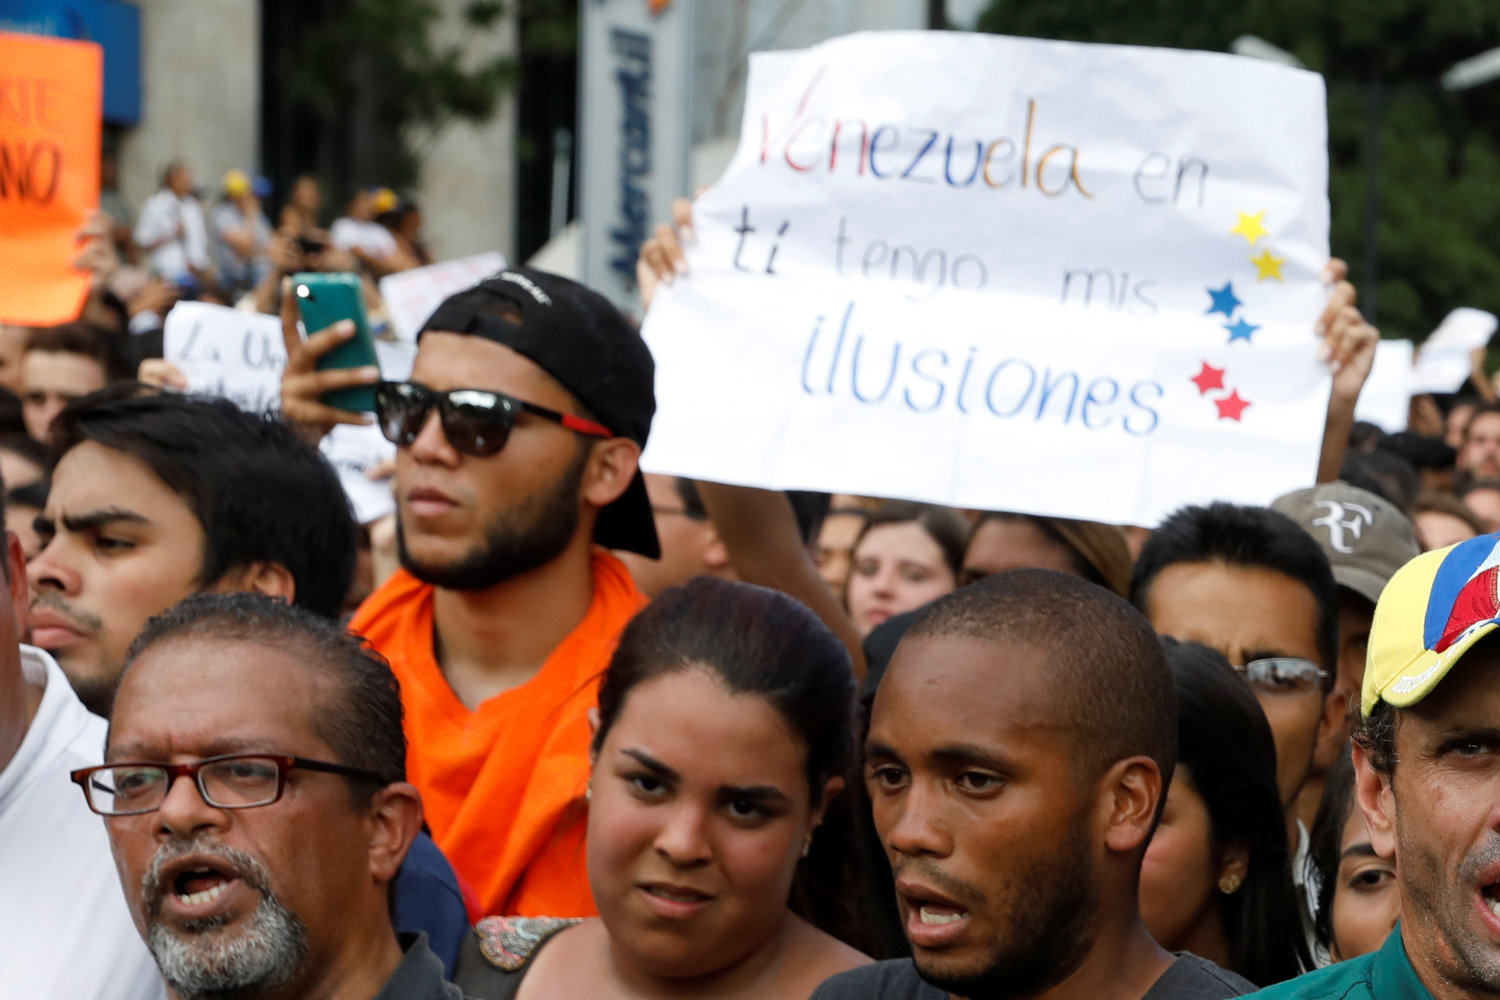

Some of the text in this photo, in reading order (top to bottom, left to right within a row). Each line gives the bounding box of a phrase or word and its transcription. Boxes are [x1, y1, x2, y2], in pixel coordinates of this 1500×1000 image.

[760, 66, 1208, 207] Venezuela en
[831, 214, 989, 302] tengo
[1061, 266, 1159, 317] mis
[800, 301, 1165, 437] ilusiones
